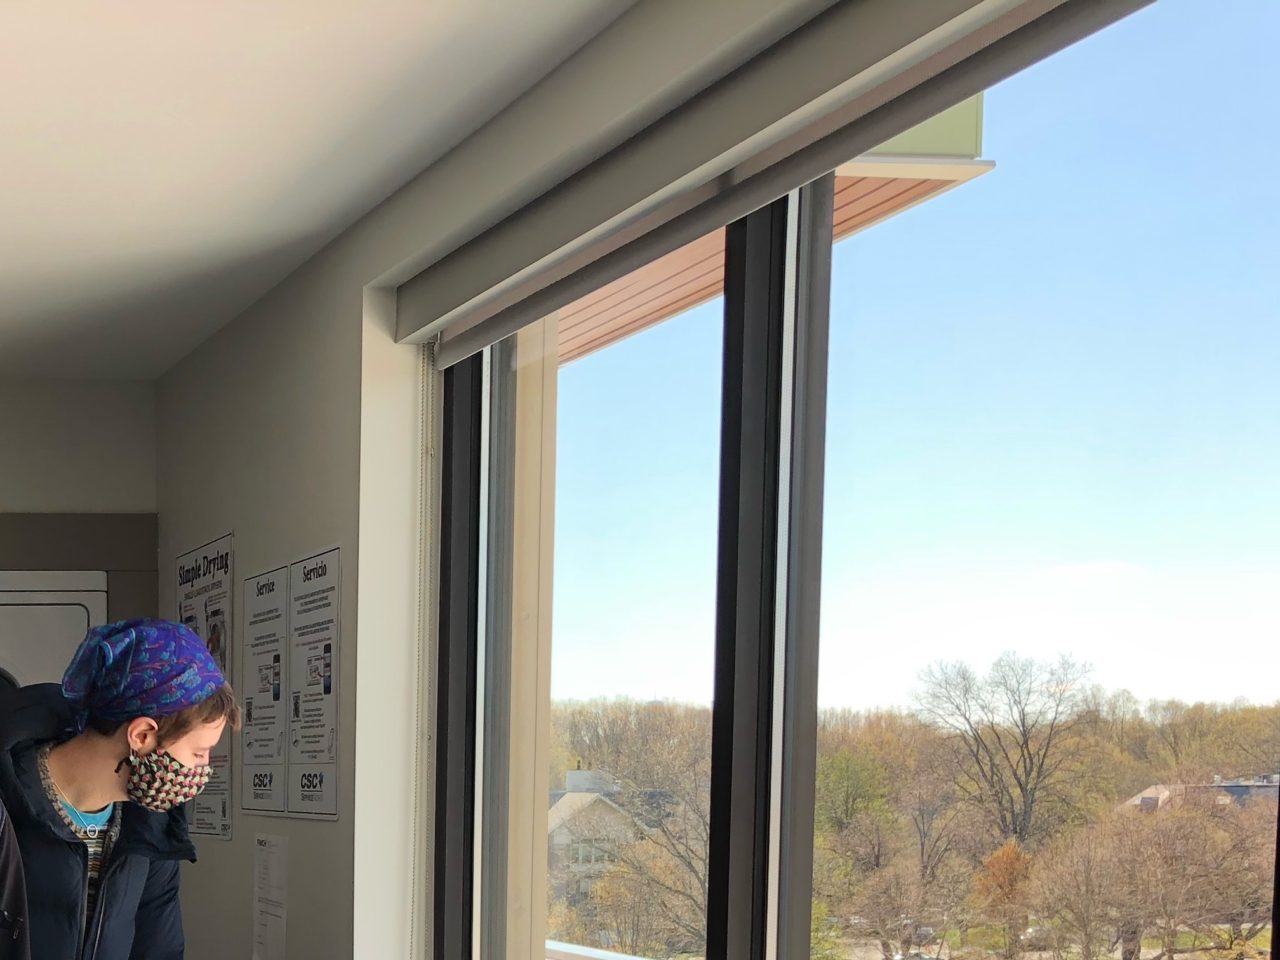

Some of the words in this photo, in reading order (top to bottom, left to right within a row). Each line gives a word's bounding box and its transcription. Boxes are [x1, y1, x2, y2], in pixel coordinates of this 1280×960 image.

[178, 558, 201, 588] Simple
[202, 550, 229, 580] Drying
[303, 561, 327, 583] Servicio
[256, 578, 275, 597] Service
[253, 773, 268, 788] CSC
[301, 773, 318, 789] CSC
